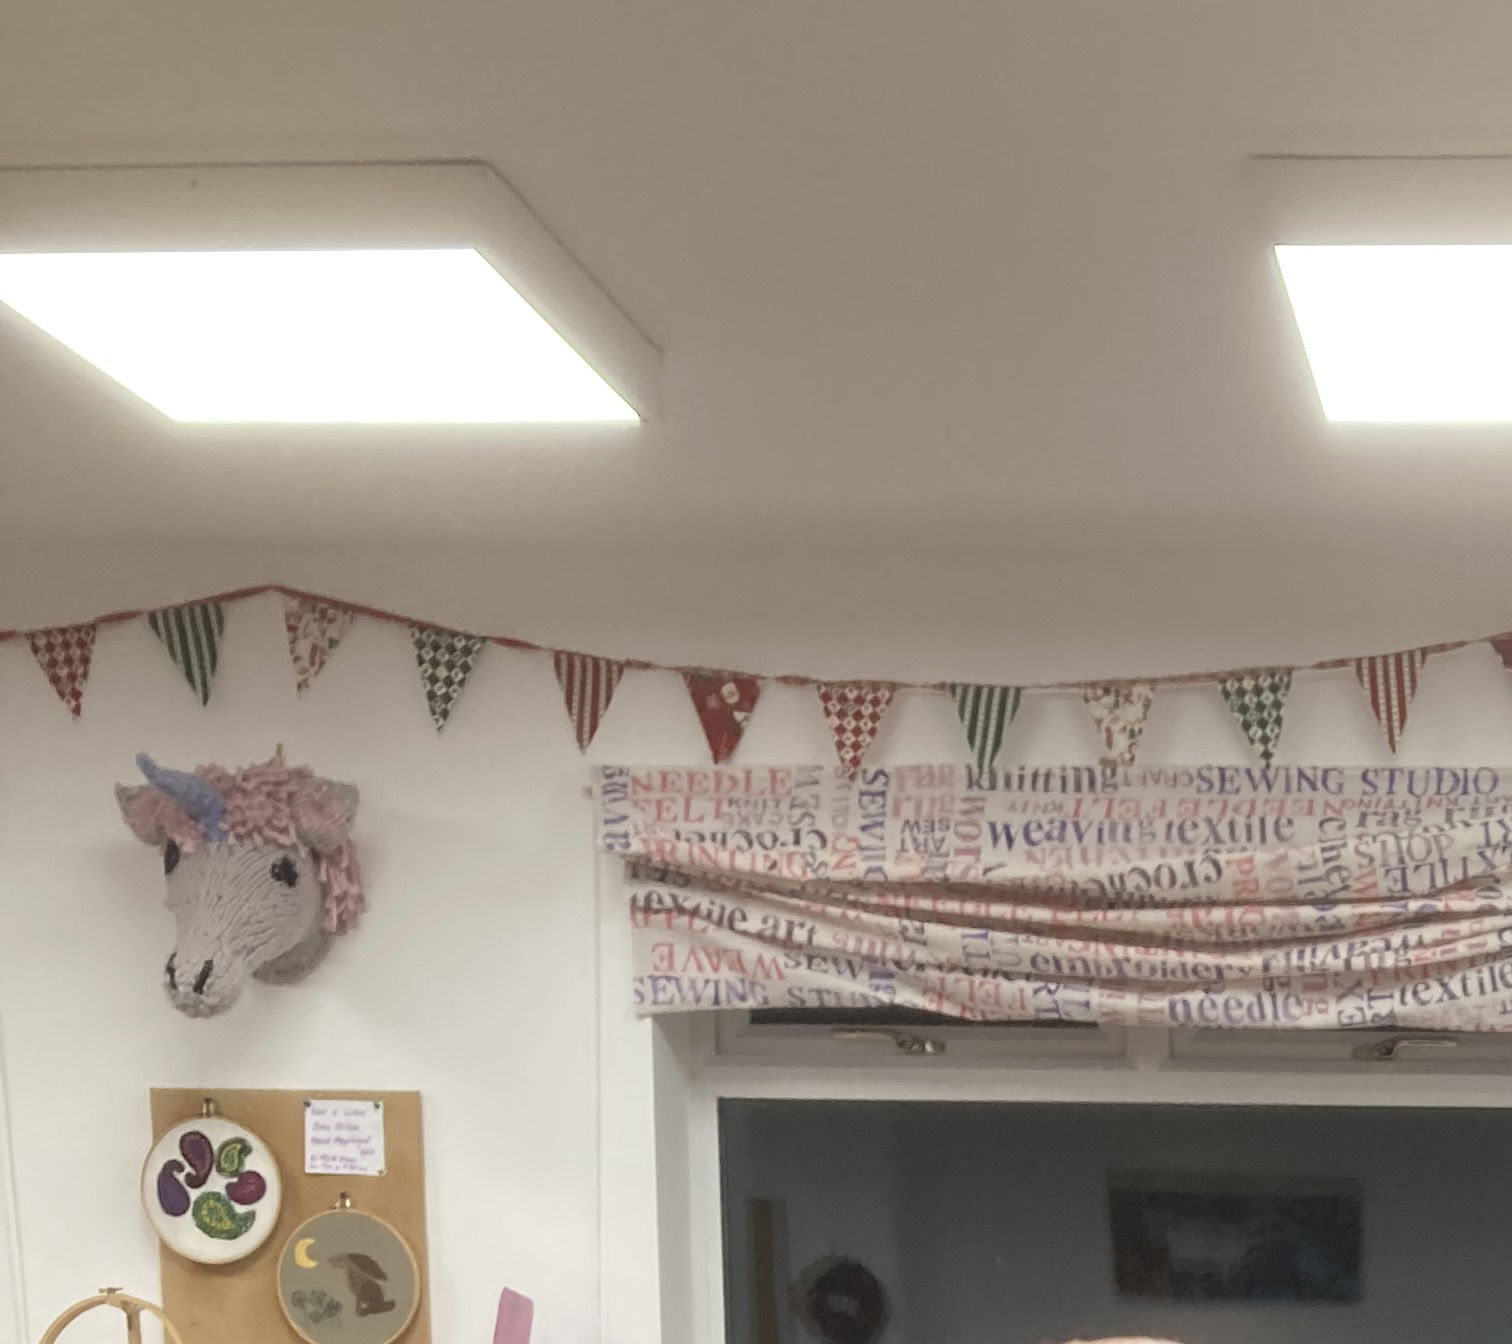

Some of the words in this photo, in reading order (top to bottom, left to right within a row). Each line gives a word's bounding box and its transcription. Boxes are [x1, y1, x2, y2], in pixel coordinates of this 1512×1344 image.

[630, 769, 794, 798] NEEDLE
[1122, 769, 1194, 788] CRAFT
[1196, 766, 1345, 796] SEWING
[1360, 767, 1499, 799] STUDIO
[1177, 798, 1344, 818] NEEDLE
[672, 828, 828, 850] crochet
[987, 819, 1157, 850] weaving
[1164, 815, 1296, 846] textile
[630, 889, 747, 932] texile
[757, 913, 820, 947] art
[652, 942, 785, 981] WEAVE
[631, 974, 769, 1006] SEWING
[1167, 990, 1301, 1025] needle
